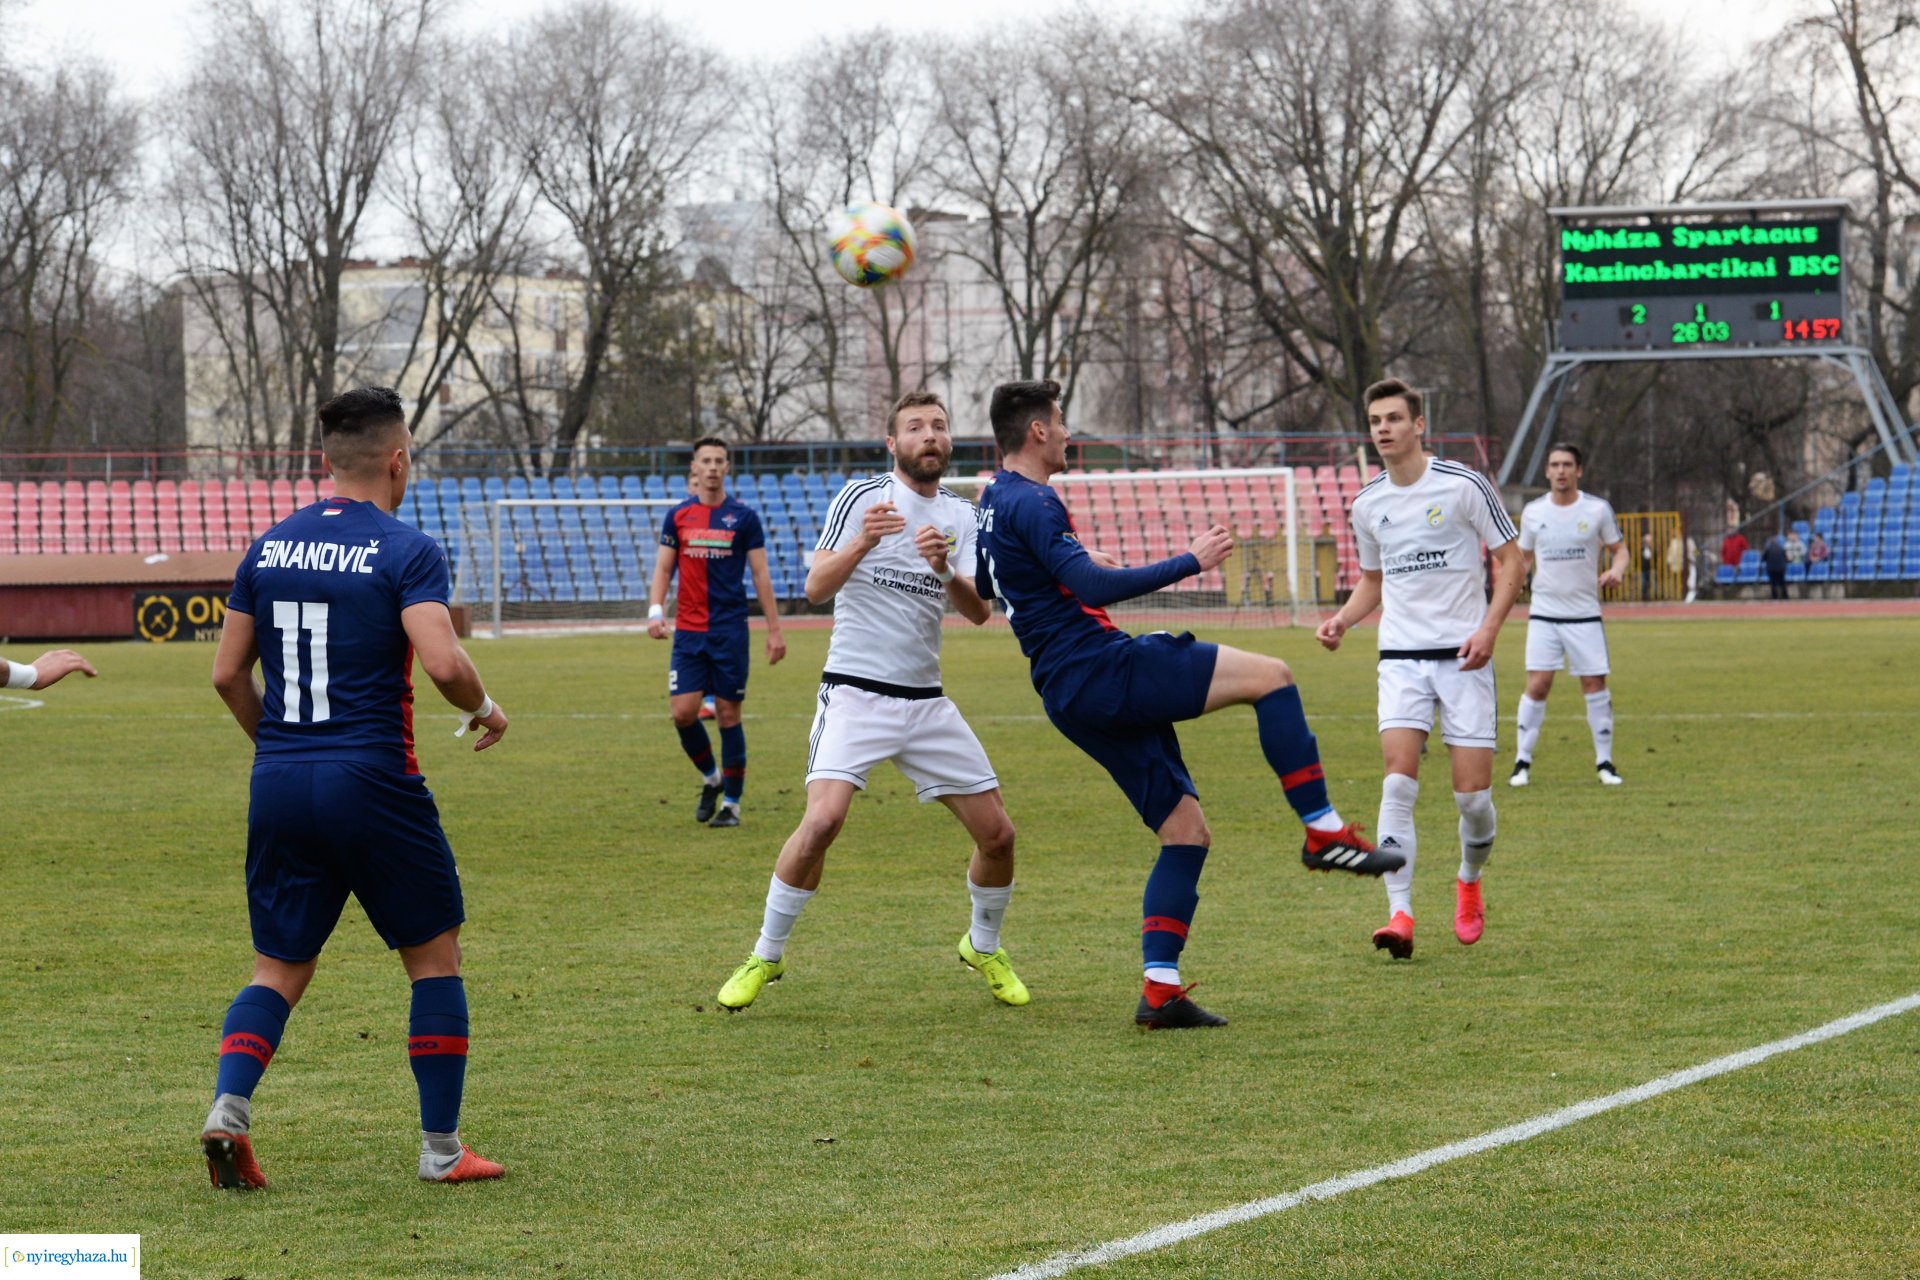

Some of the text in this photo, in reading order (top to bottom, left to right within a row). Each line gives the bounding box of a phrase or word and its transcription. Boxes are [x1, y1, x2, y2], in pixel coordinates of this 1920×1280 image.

[1671, 225, 1818, 248] Spartacus
[1564, 254, 1840, 283] Kazincbarcikai BSC
[1631, 300, 1781, 324] 2 1 1
[257, 539, 379, 574] SINANOVIČ
[272, 600, 331, 723] 11
